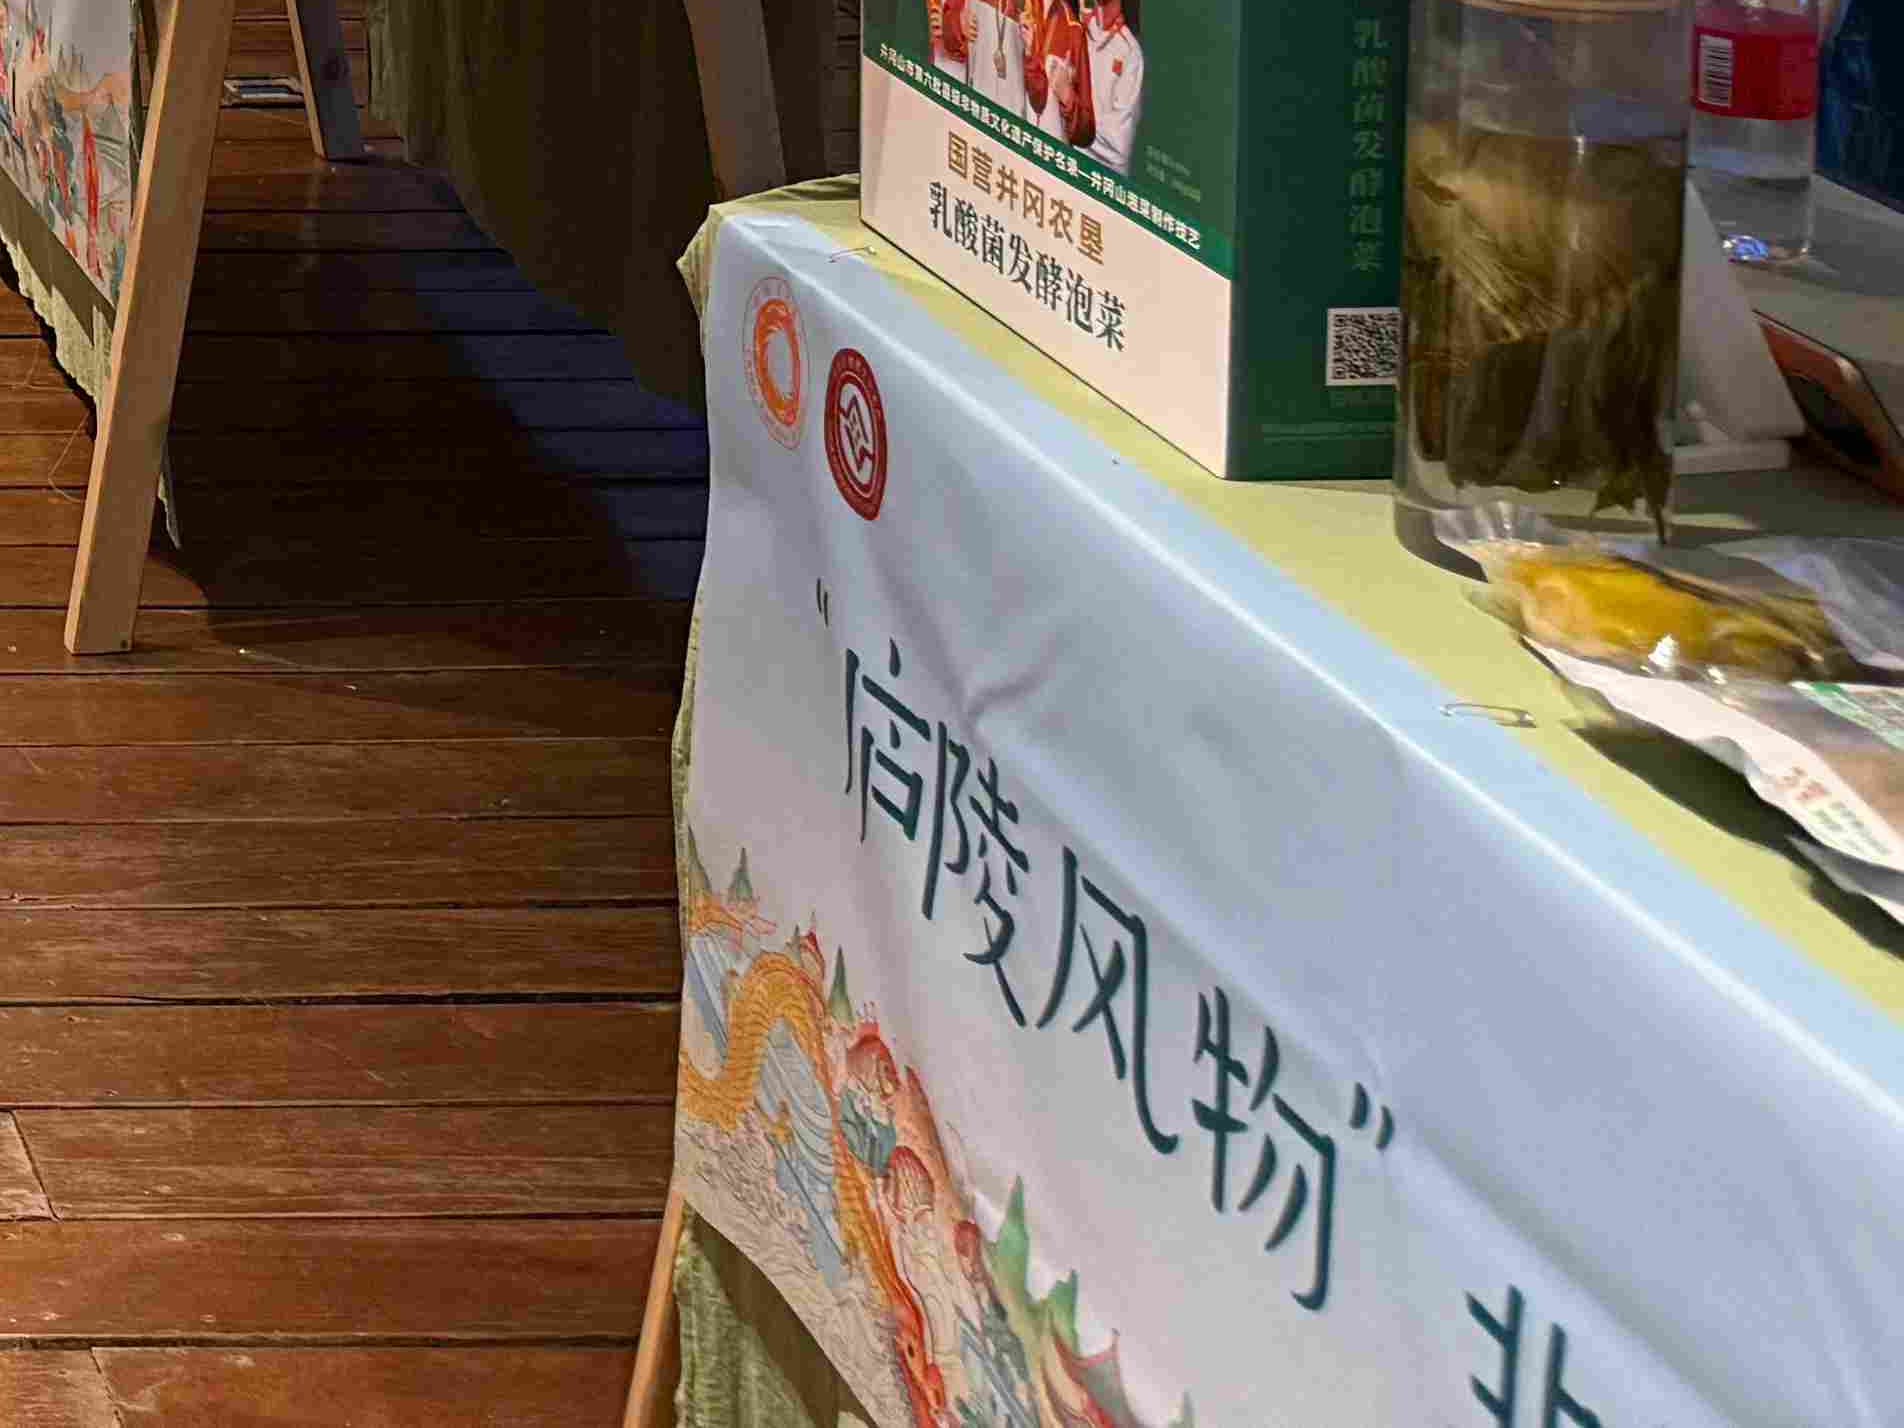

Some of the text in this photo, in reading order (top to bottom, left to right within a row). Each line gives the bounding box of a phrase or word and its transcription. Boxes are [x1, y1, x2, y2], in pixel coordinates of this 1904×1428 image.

[928, 181, 1126, 352] 乳酸菌发酵泡菜
[948, 130, 1105, 266] 国营井冈农垦
